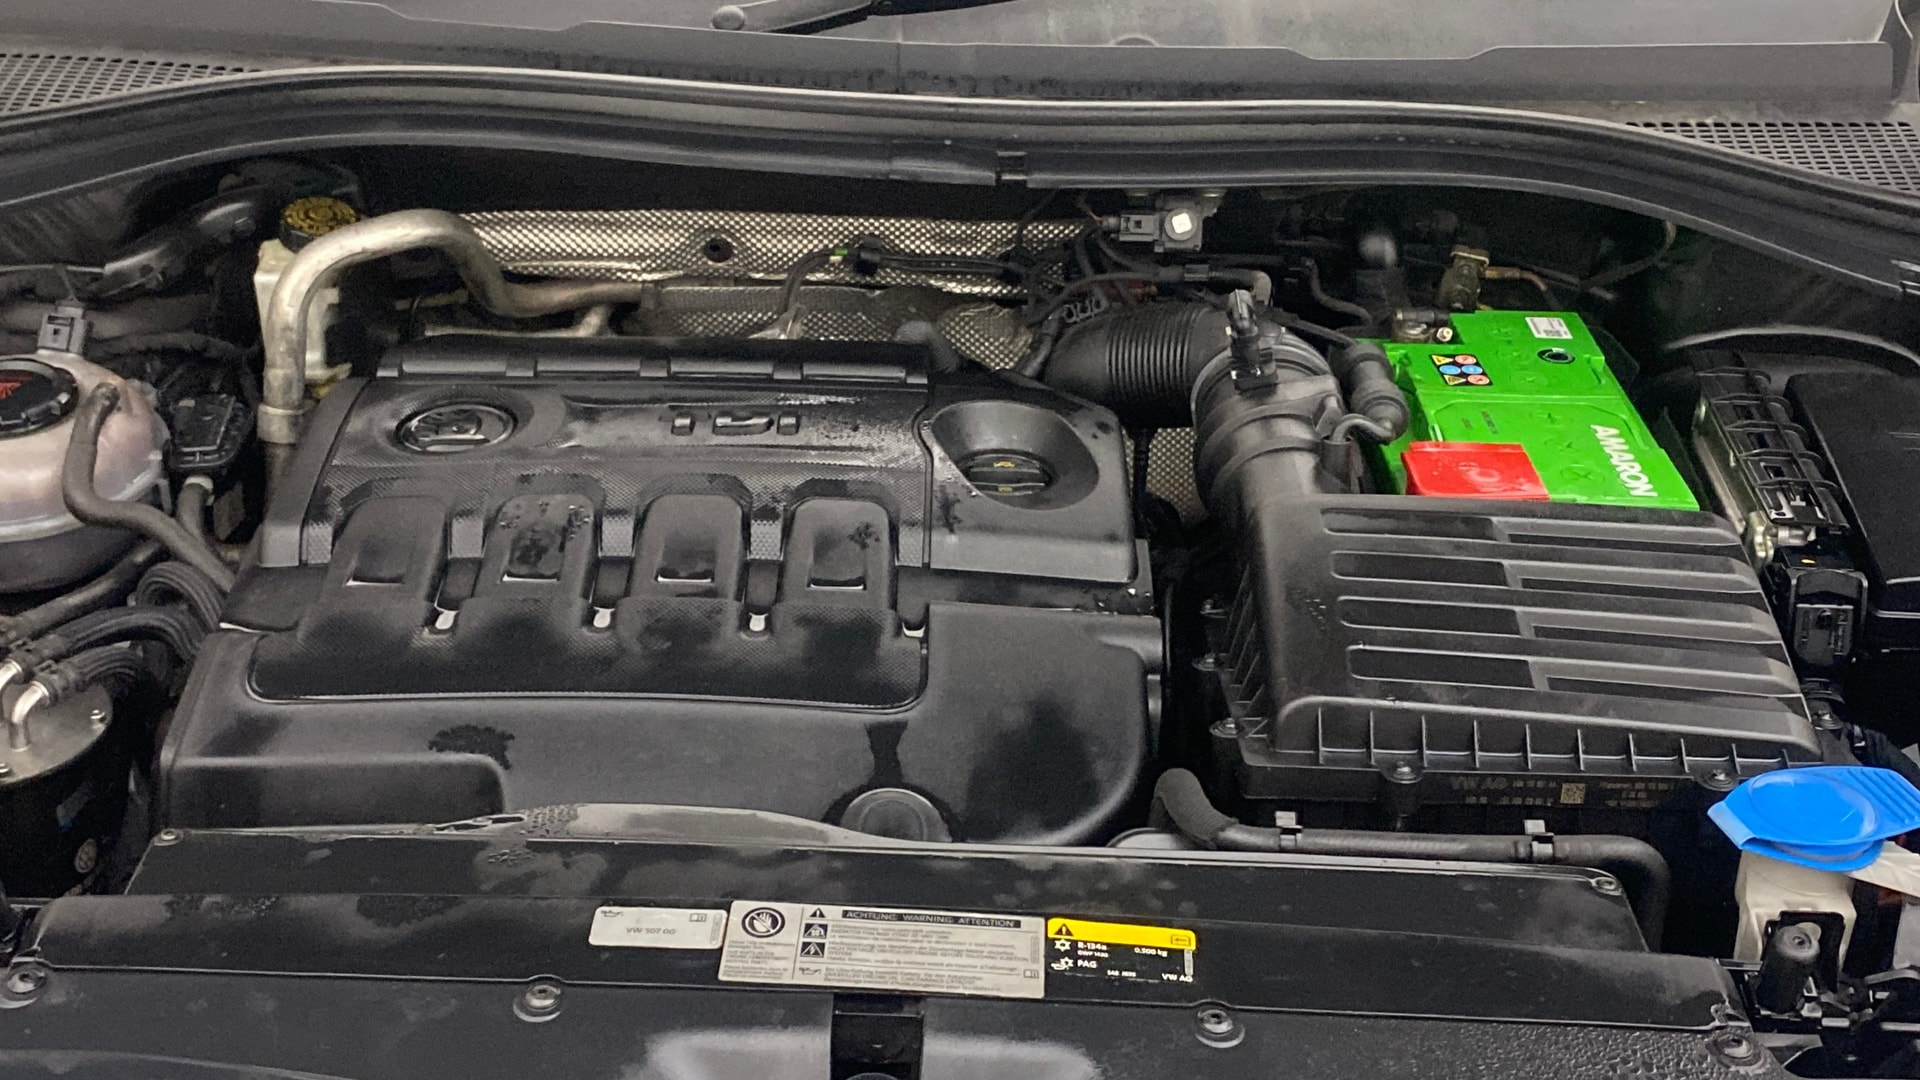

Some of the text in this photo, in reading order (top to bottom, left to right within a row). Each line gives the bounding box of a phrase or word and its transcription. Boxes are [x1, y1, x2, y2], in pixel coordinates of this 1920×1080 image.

[1590, 424, 1659, 498] AMARON
[845, 911, 1015, 928] ACHTUNG WARNING ATTENTION
[626, 926, 643, 934] VW
[1077, 941, 1107, 951] R-134a
[1157, 948, 1168, 958] kg
[1077, 959, 1097, 969] PAG
[1161, 972, 1193, 983] VW AG
